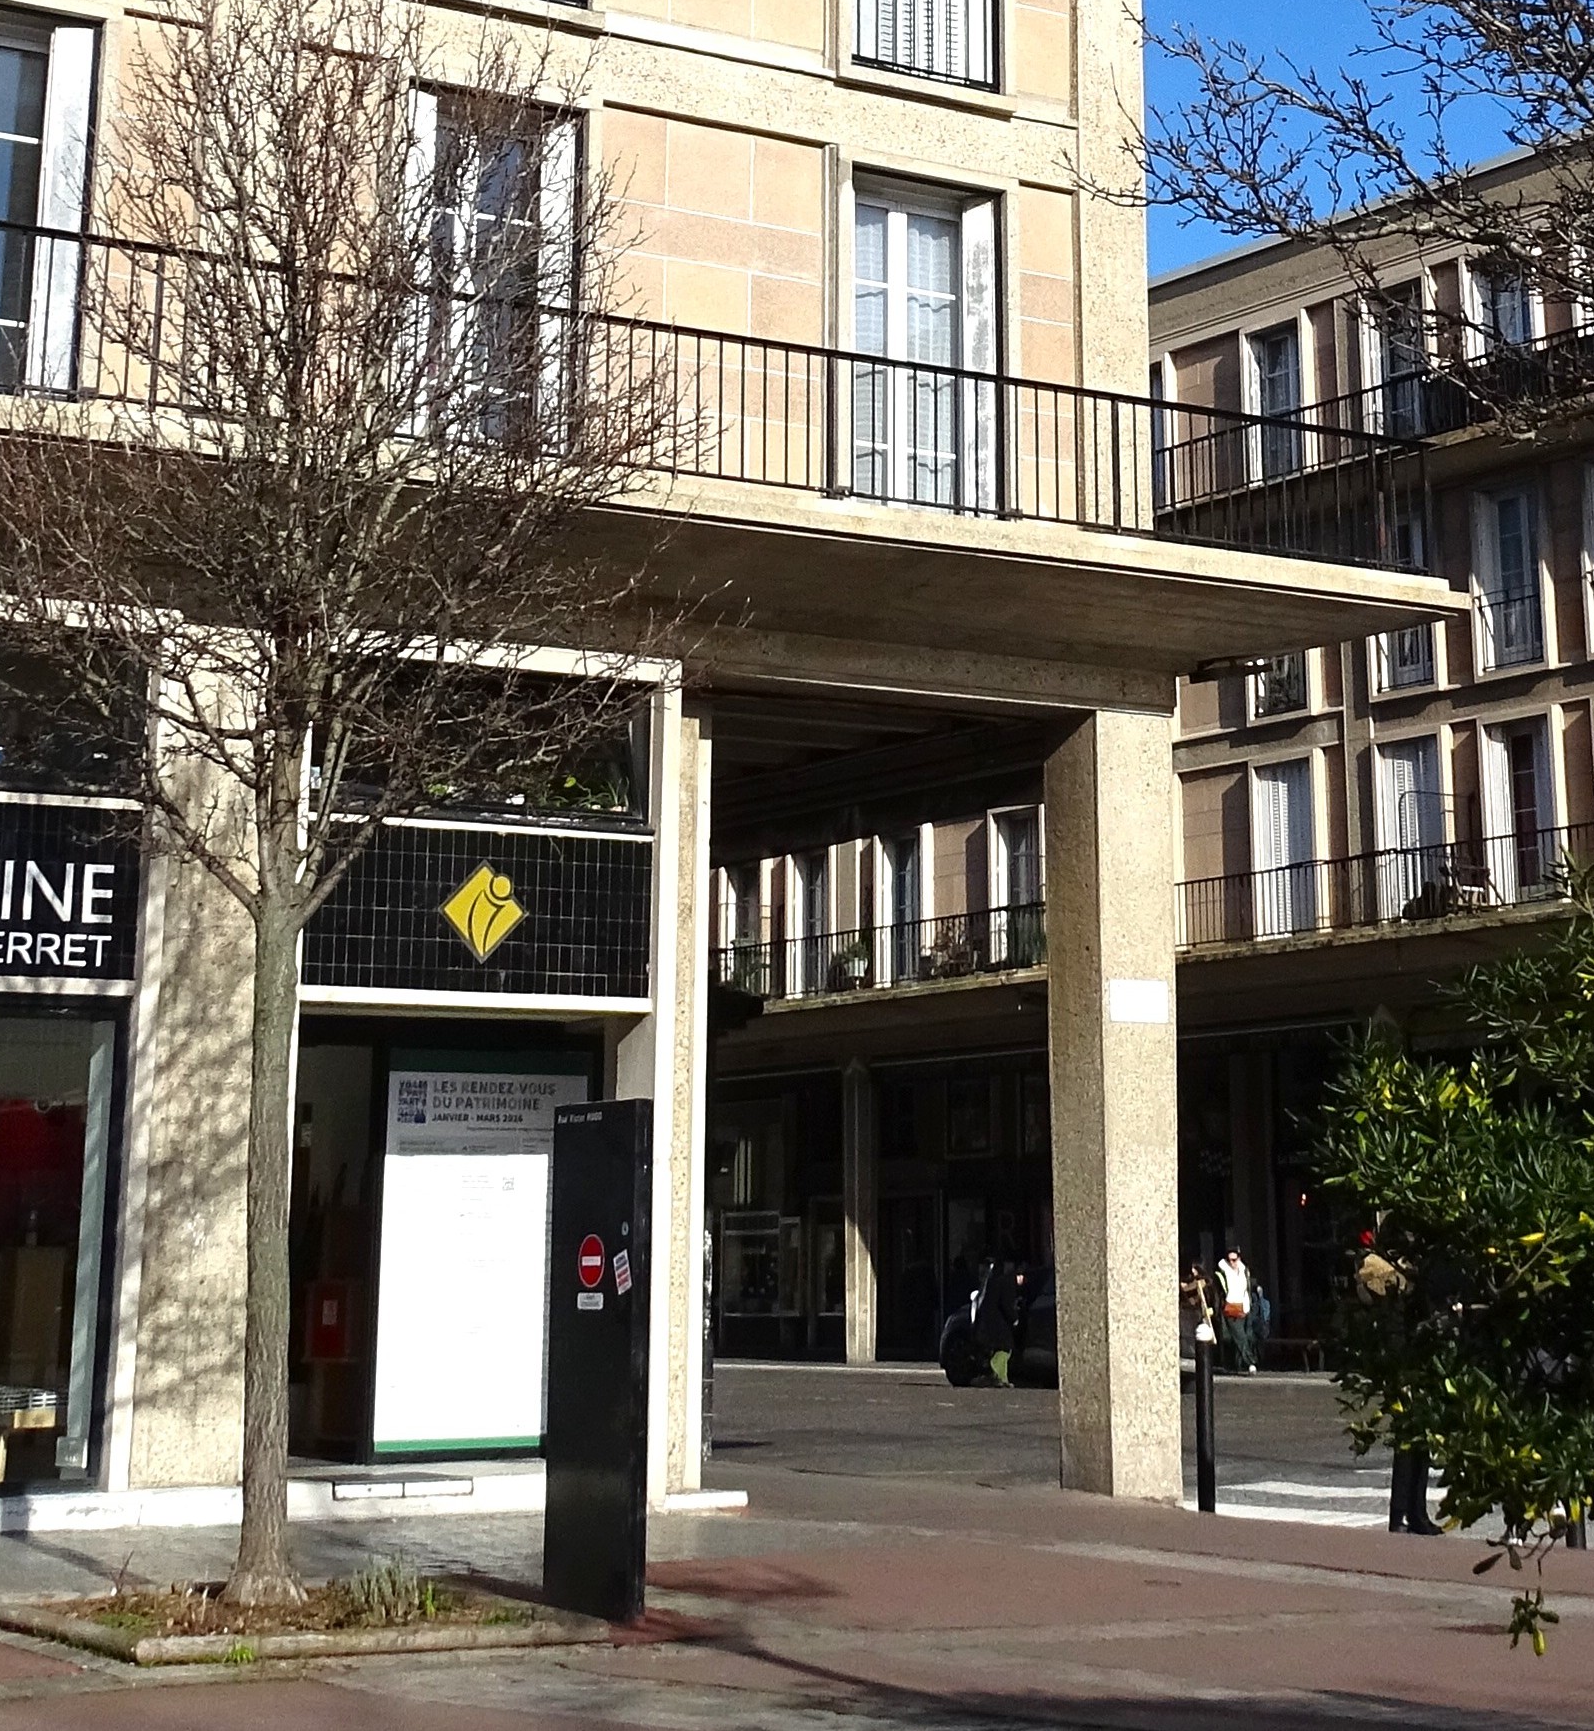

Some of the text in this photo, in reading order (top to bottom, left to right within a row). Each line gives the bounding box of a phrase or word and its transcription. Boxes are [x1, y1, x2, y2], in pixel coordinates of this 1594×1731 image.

[433, 1080, 456, 1094] LES
[432, 1096, 540, 1111] DU PATRIMOINE
[431, 1113, 469, 1122] JANVIER
[475, 1113, 500, 1122] MARS
